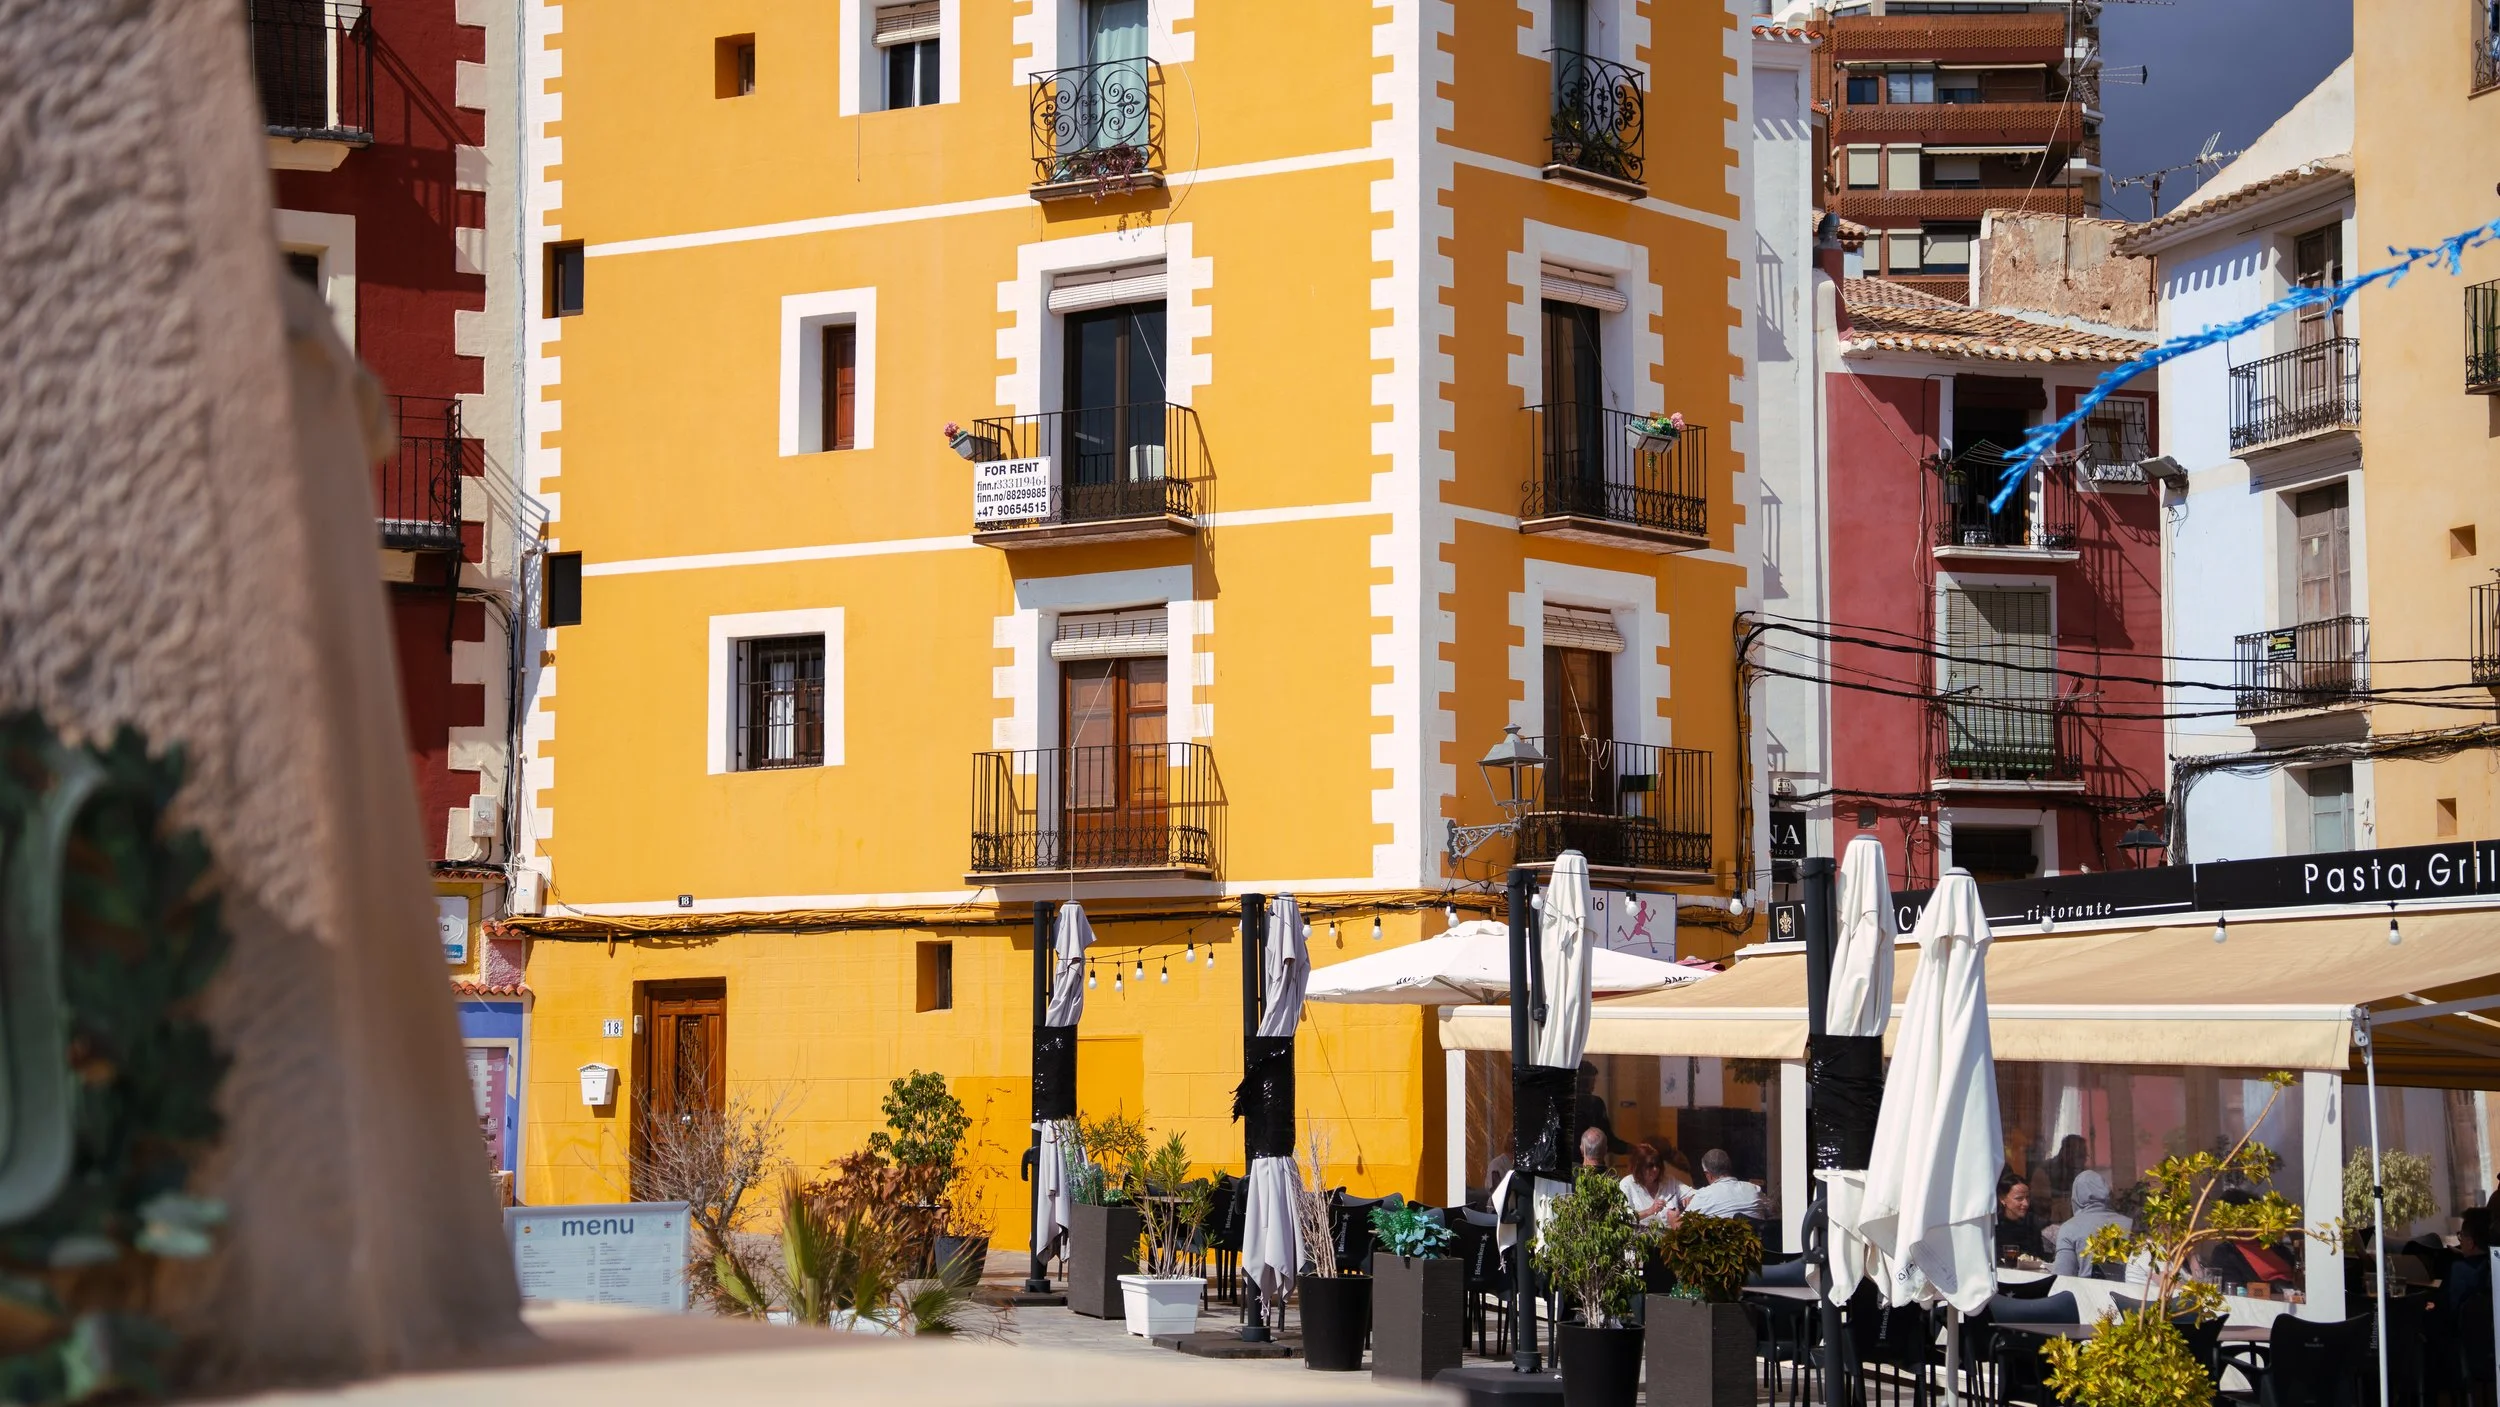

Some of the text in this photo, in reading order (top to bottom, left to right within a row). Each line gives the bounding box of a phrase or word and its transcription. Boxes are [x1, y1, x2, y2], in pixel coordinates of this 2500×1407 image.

[985, 462, 1039, 476] FOR RENT
[977, 502, 1047, 517] +47 90654515
[2027, 902, 2111, 920] ritorante
[608, 1022, 619, 1034] 18
[562, 1218, 634, 1236] menu
[1475, 1243, 1486, 1275] Heineken
